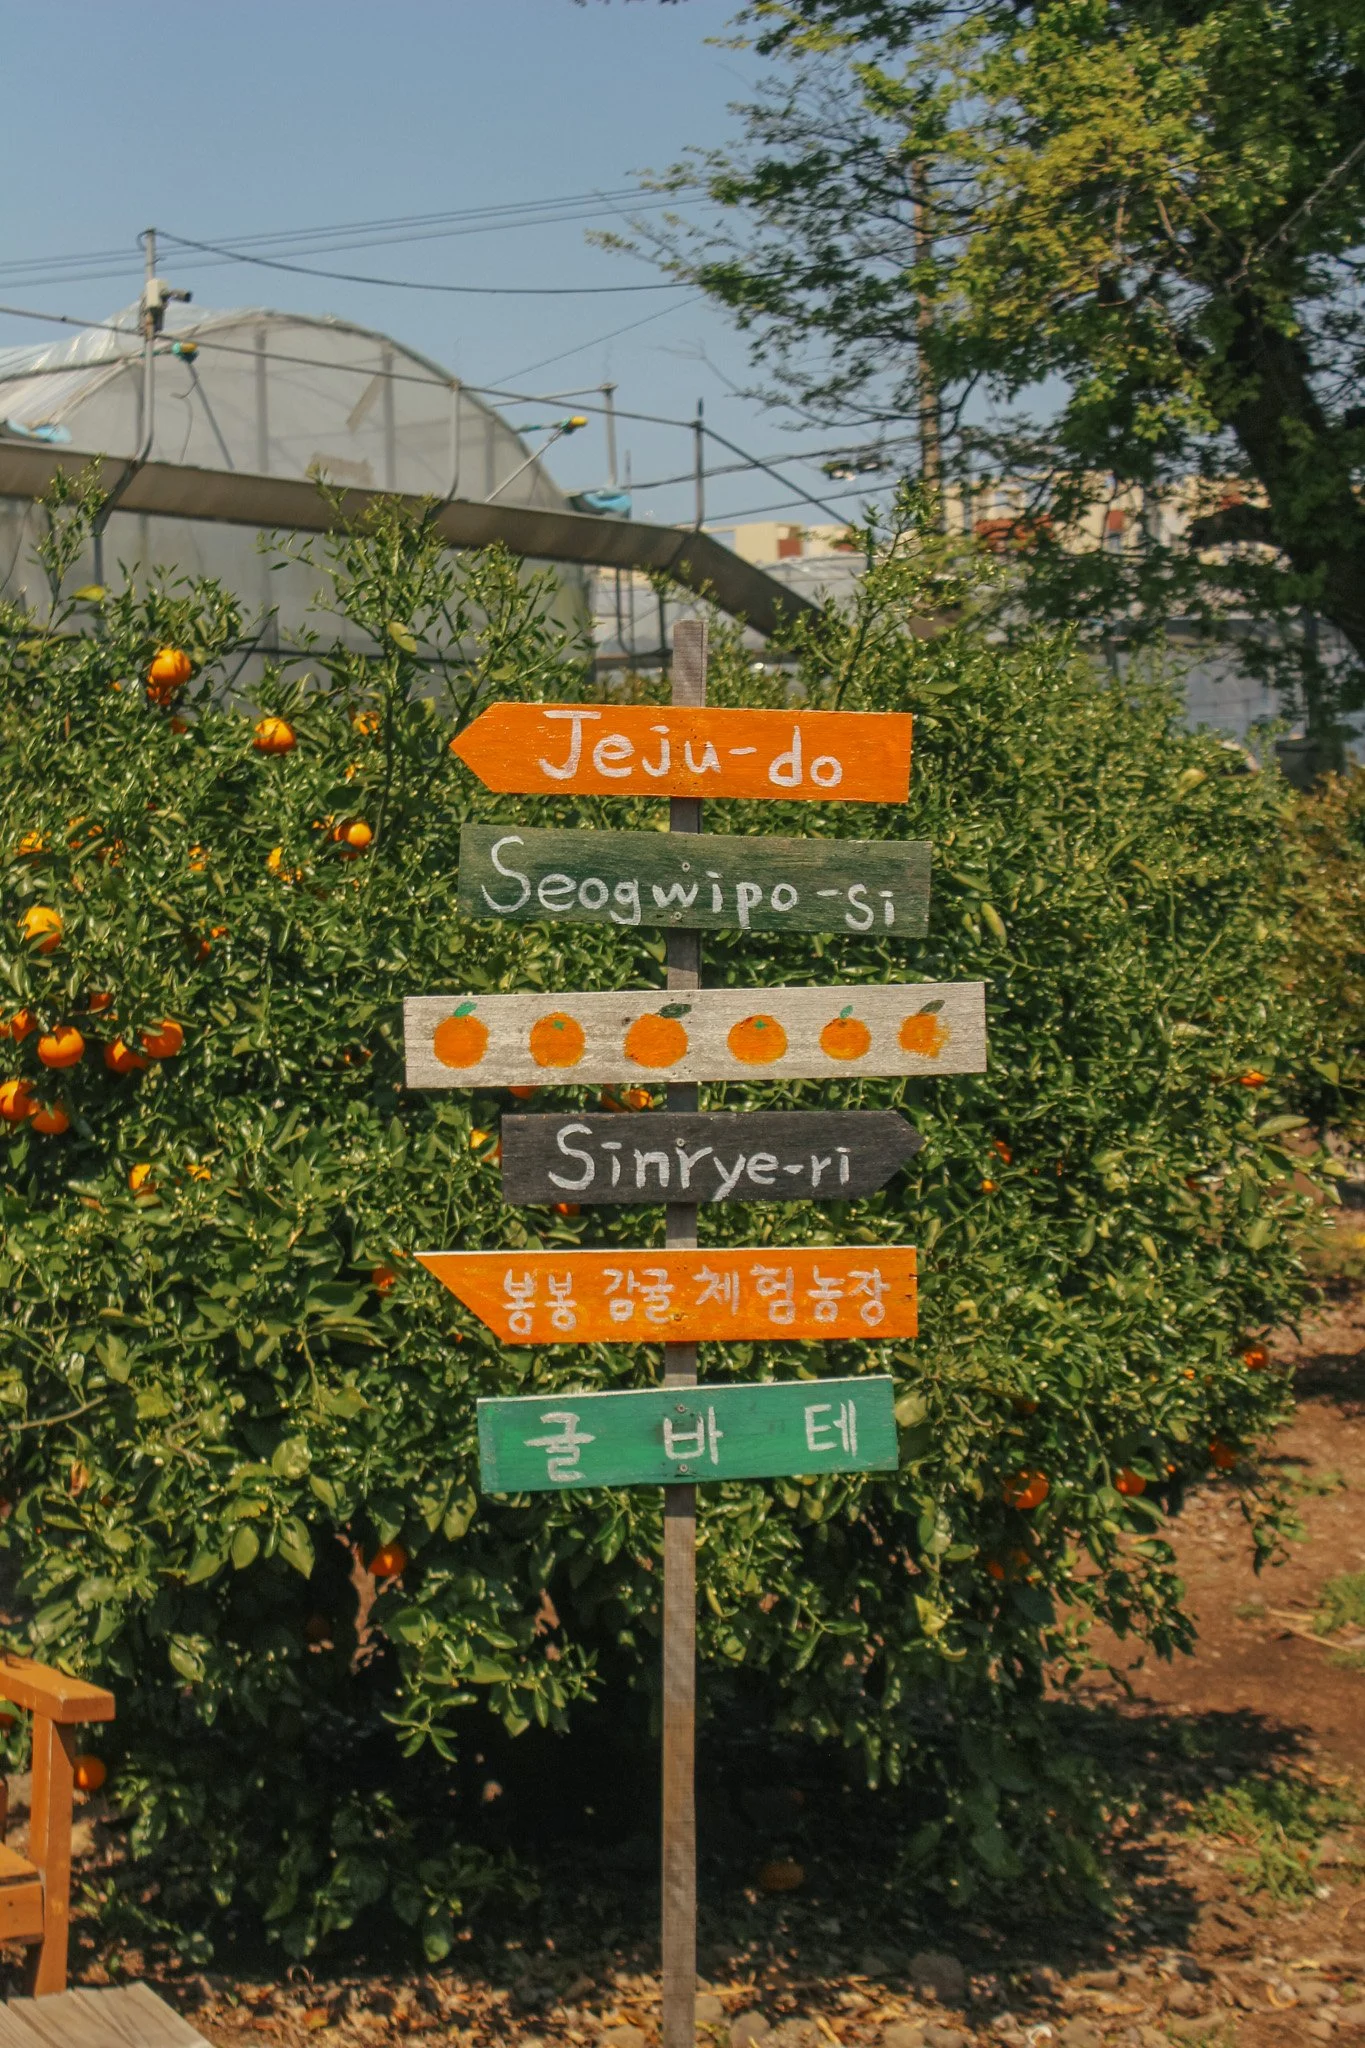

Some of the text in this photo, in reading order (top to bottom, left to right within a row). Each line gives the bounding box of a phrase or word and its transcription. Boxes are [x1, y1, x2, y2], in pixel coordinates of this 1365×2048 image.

[538, 710, 844, 788] Jeju-do
[480, 835, 896, 931] Seogwipo-si
[547, 1123, 851, 1201] Sinrye-ri
[502, 1268, 578, 1336] 봉봉
[601, 1267, 676, 1325] 감귤
